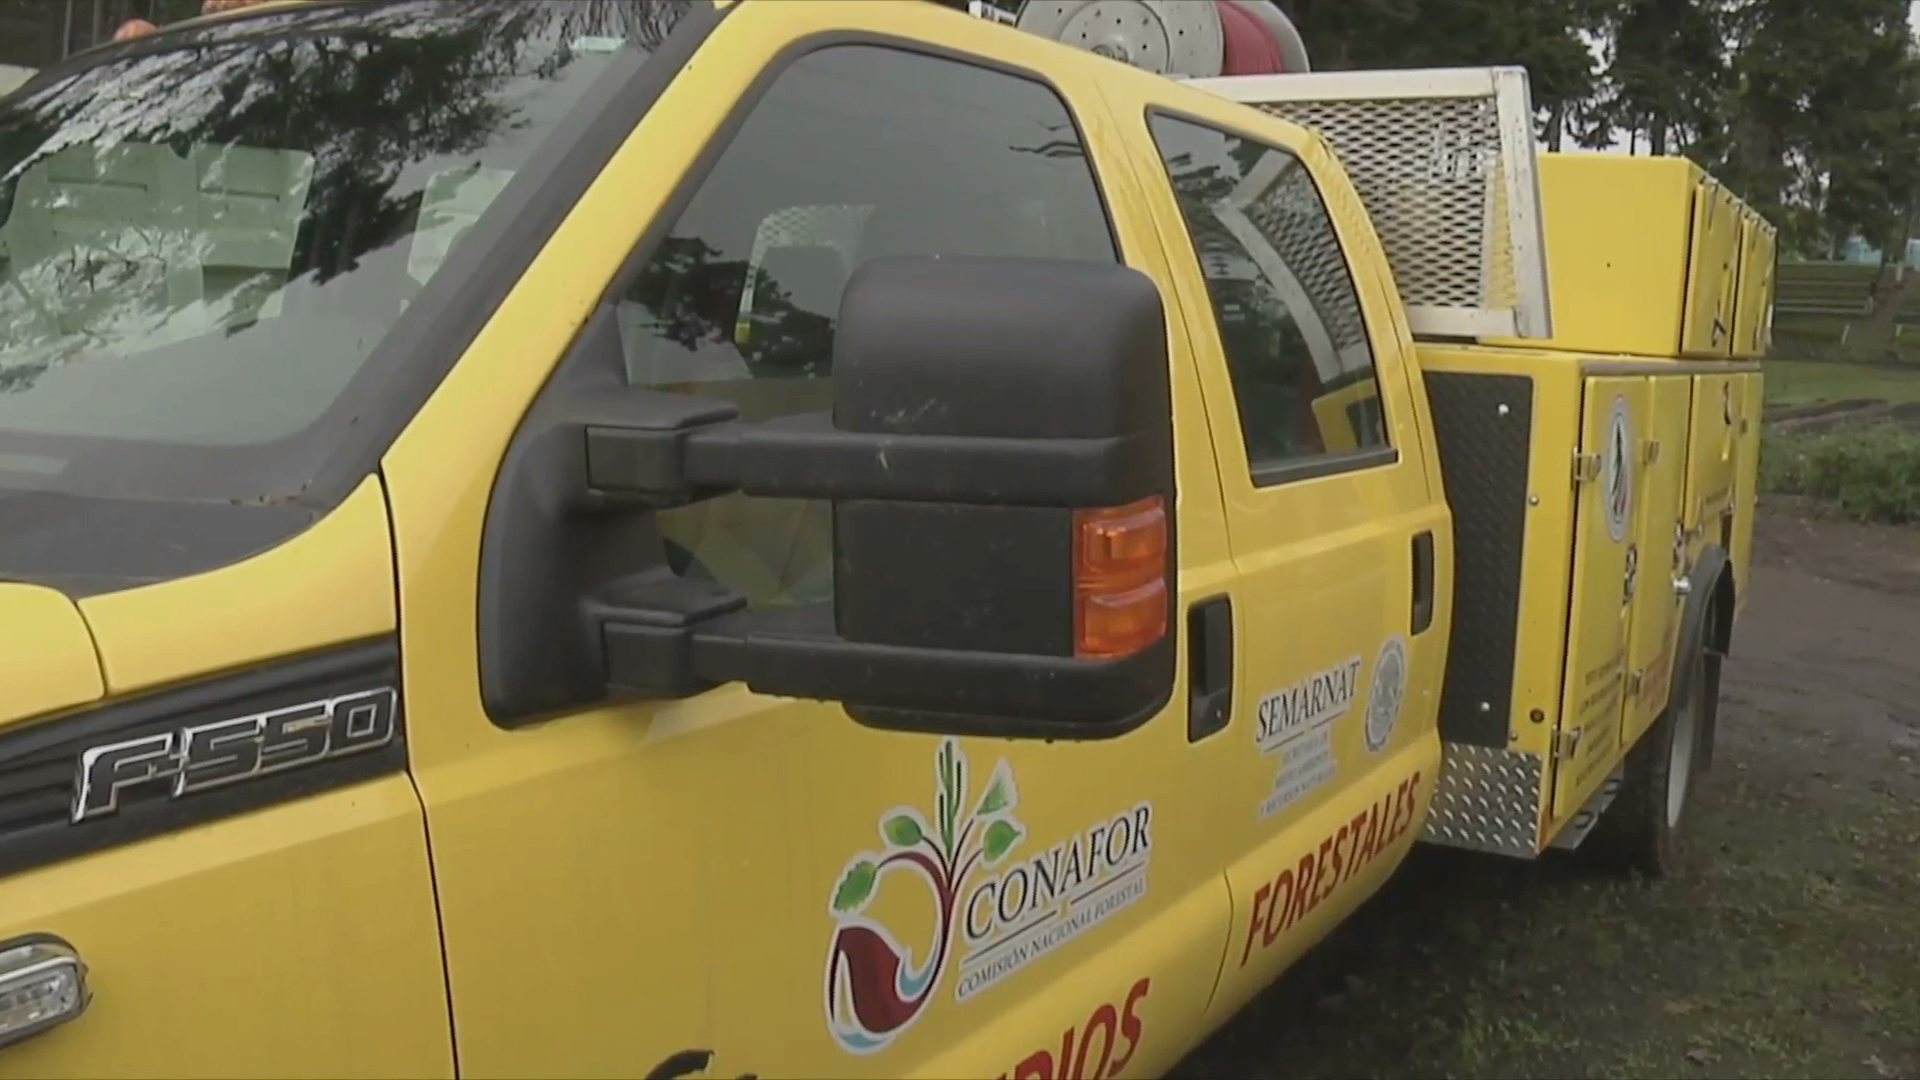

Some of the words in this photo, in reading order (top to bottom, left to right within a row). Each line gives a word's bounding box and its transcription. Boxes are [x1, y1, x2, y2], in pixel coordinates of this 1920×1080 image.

[1257, 662, 1360, 742] SEMARNAT
[967, 806, 1150, 939] CONAFOR
[1030, 911, 1094, 957] NACIONAL
[1094, 881, 1145, 921] FORESTAL
[1241, 772, 1420, 966] FORESTALES
